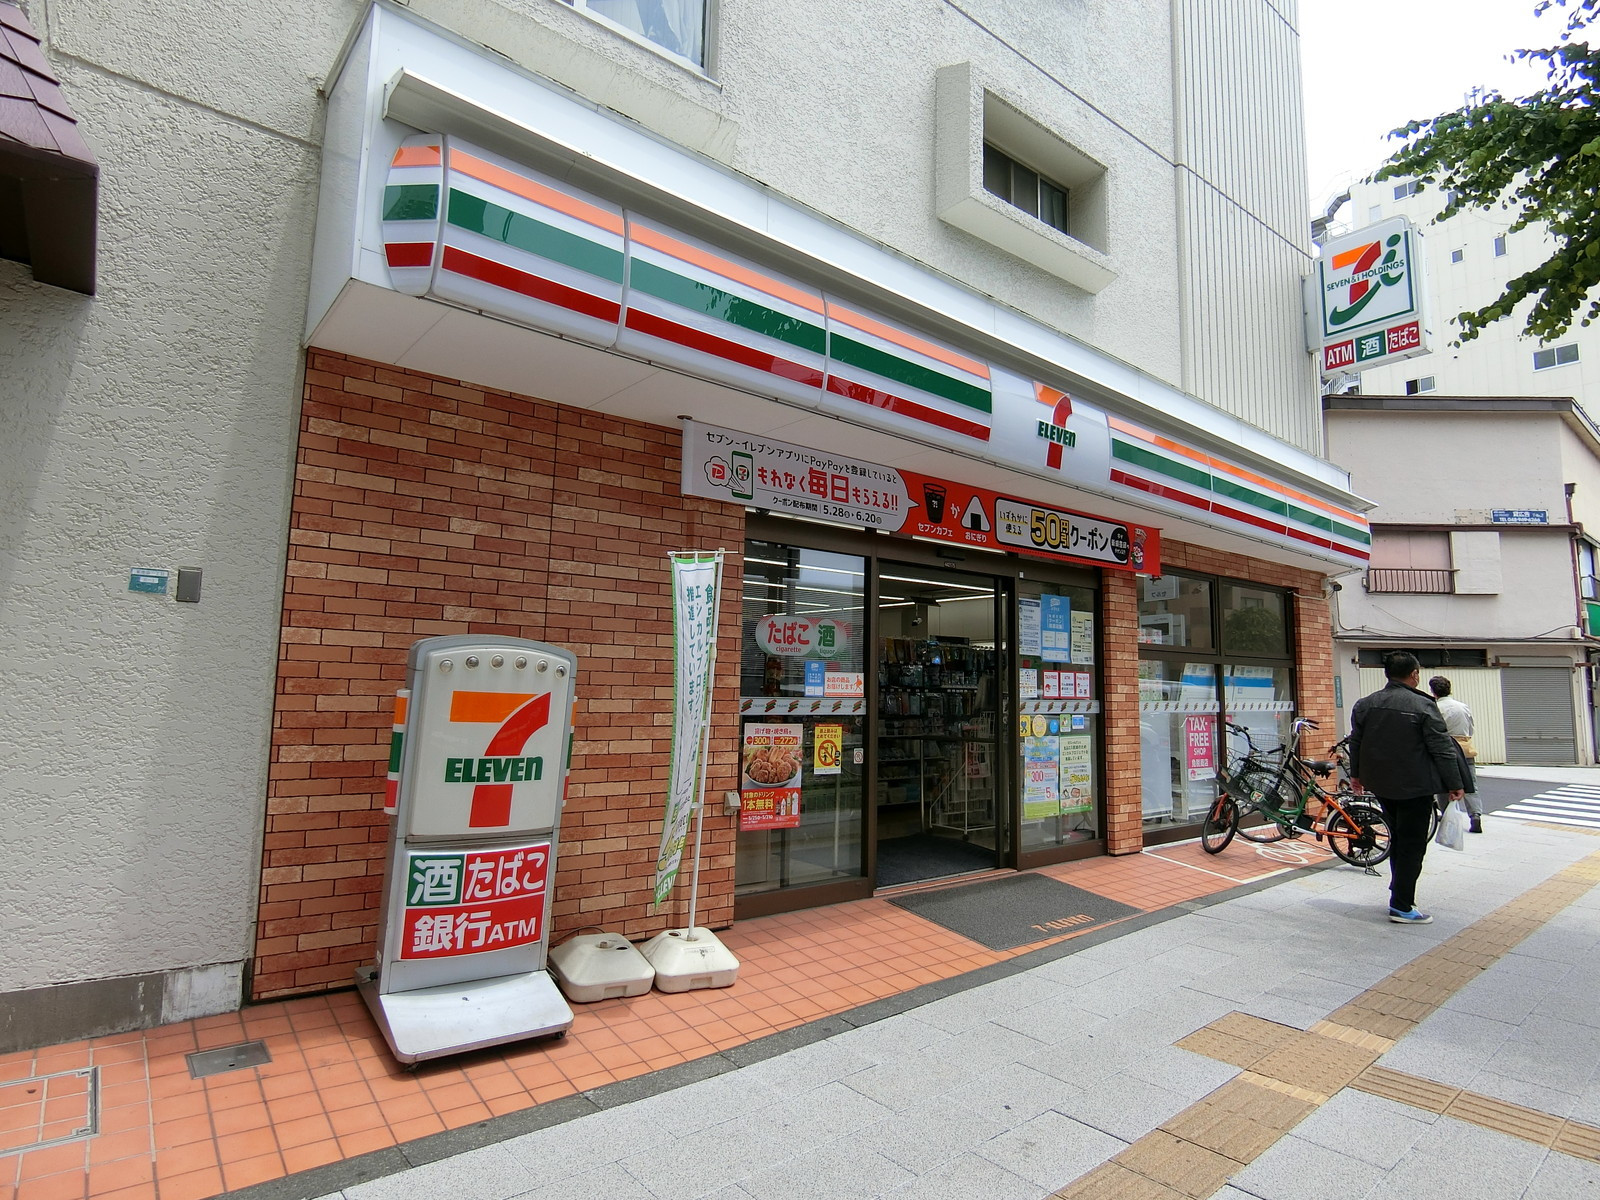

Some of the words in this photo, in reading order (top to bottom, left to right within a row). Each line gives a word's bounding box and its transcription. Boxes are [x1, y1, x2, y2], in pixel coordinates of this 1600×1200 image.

[1361, 259, 1405, 280] HOLDINGS
[1327, 344, 1352, 366] ATM
[1361, 336, 1380, 358] 酒
[1388, 326, 1419, 350] たばこ
[950, 503, 960, 519] か
[1000, 511, 1028, 524] いずれかに
[917, 522, 953, 537] セブンカフェ
[1006, 523, 1022, 535] 使える
[965, 531, 987, 543] おにぎり
[767, 620, 810, 645] たばこ
[818, 624, 836, 647] 酒
[1190, 733, 1209, 746] FREE
[743, 799, 774, 810] 1本無料
[410, 858, 462, 904] 酒
[465, 851, 546, 900] たばこ
